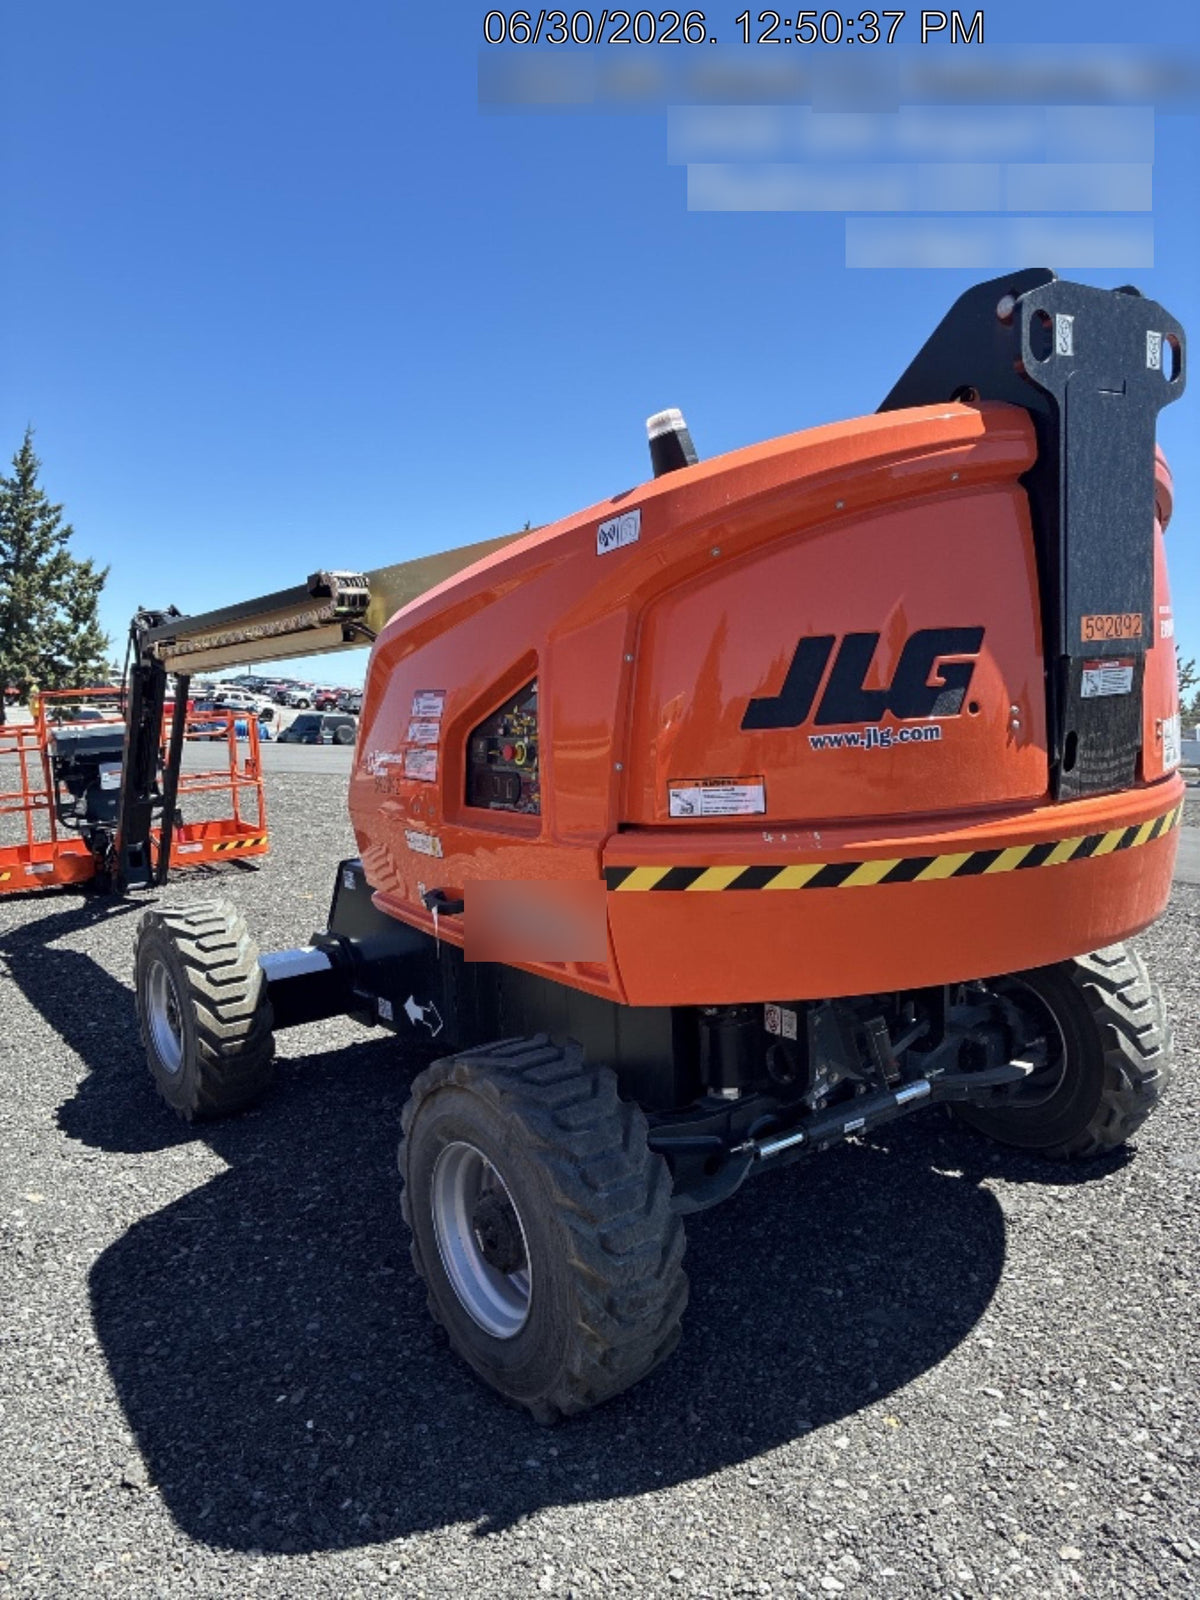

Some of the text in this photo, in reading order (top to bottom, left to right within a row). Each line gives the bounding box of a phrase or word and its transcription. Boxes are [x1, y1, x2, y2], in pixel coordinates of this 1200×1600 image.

[1085, 614, 1142, 639] 592092
[741, 626, 985, 730] JLG
[809, 725, 941, 750] www.jlg.com
